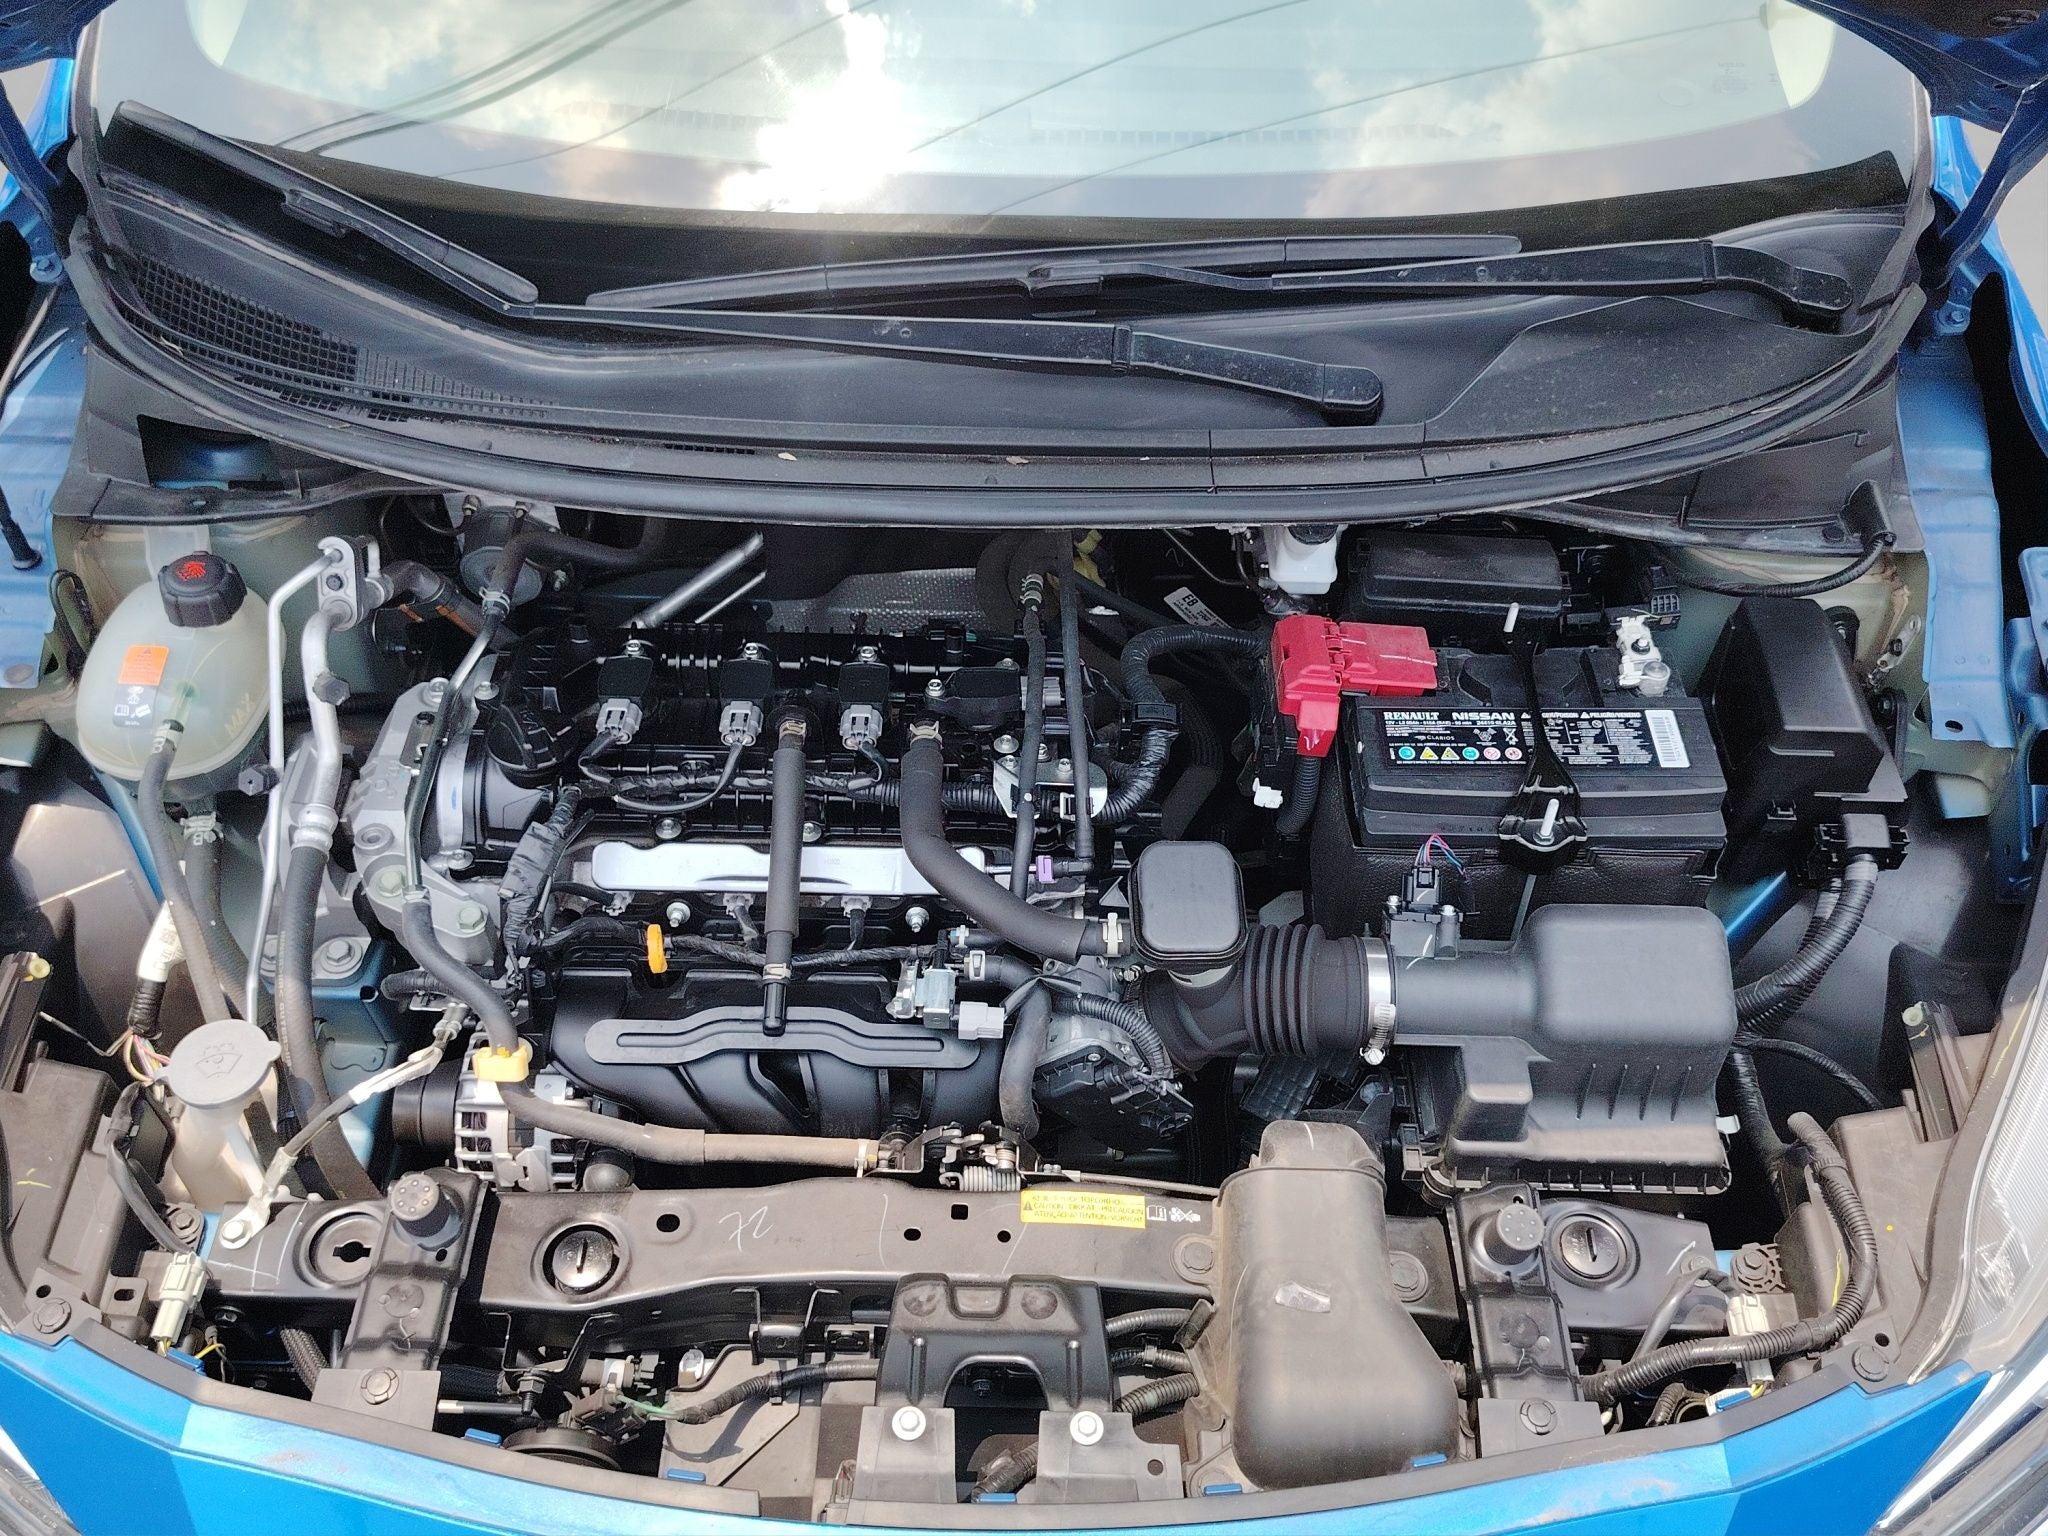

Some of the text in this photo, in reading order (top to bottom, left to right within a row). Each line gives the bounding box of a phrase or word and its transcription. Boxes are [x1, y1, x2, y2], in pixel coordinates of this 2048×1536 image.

[1182, 594, 1199, 607] EB
[1383, 711, 1515, 720] RENAULT NISSAN
